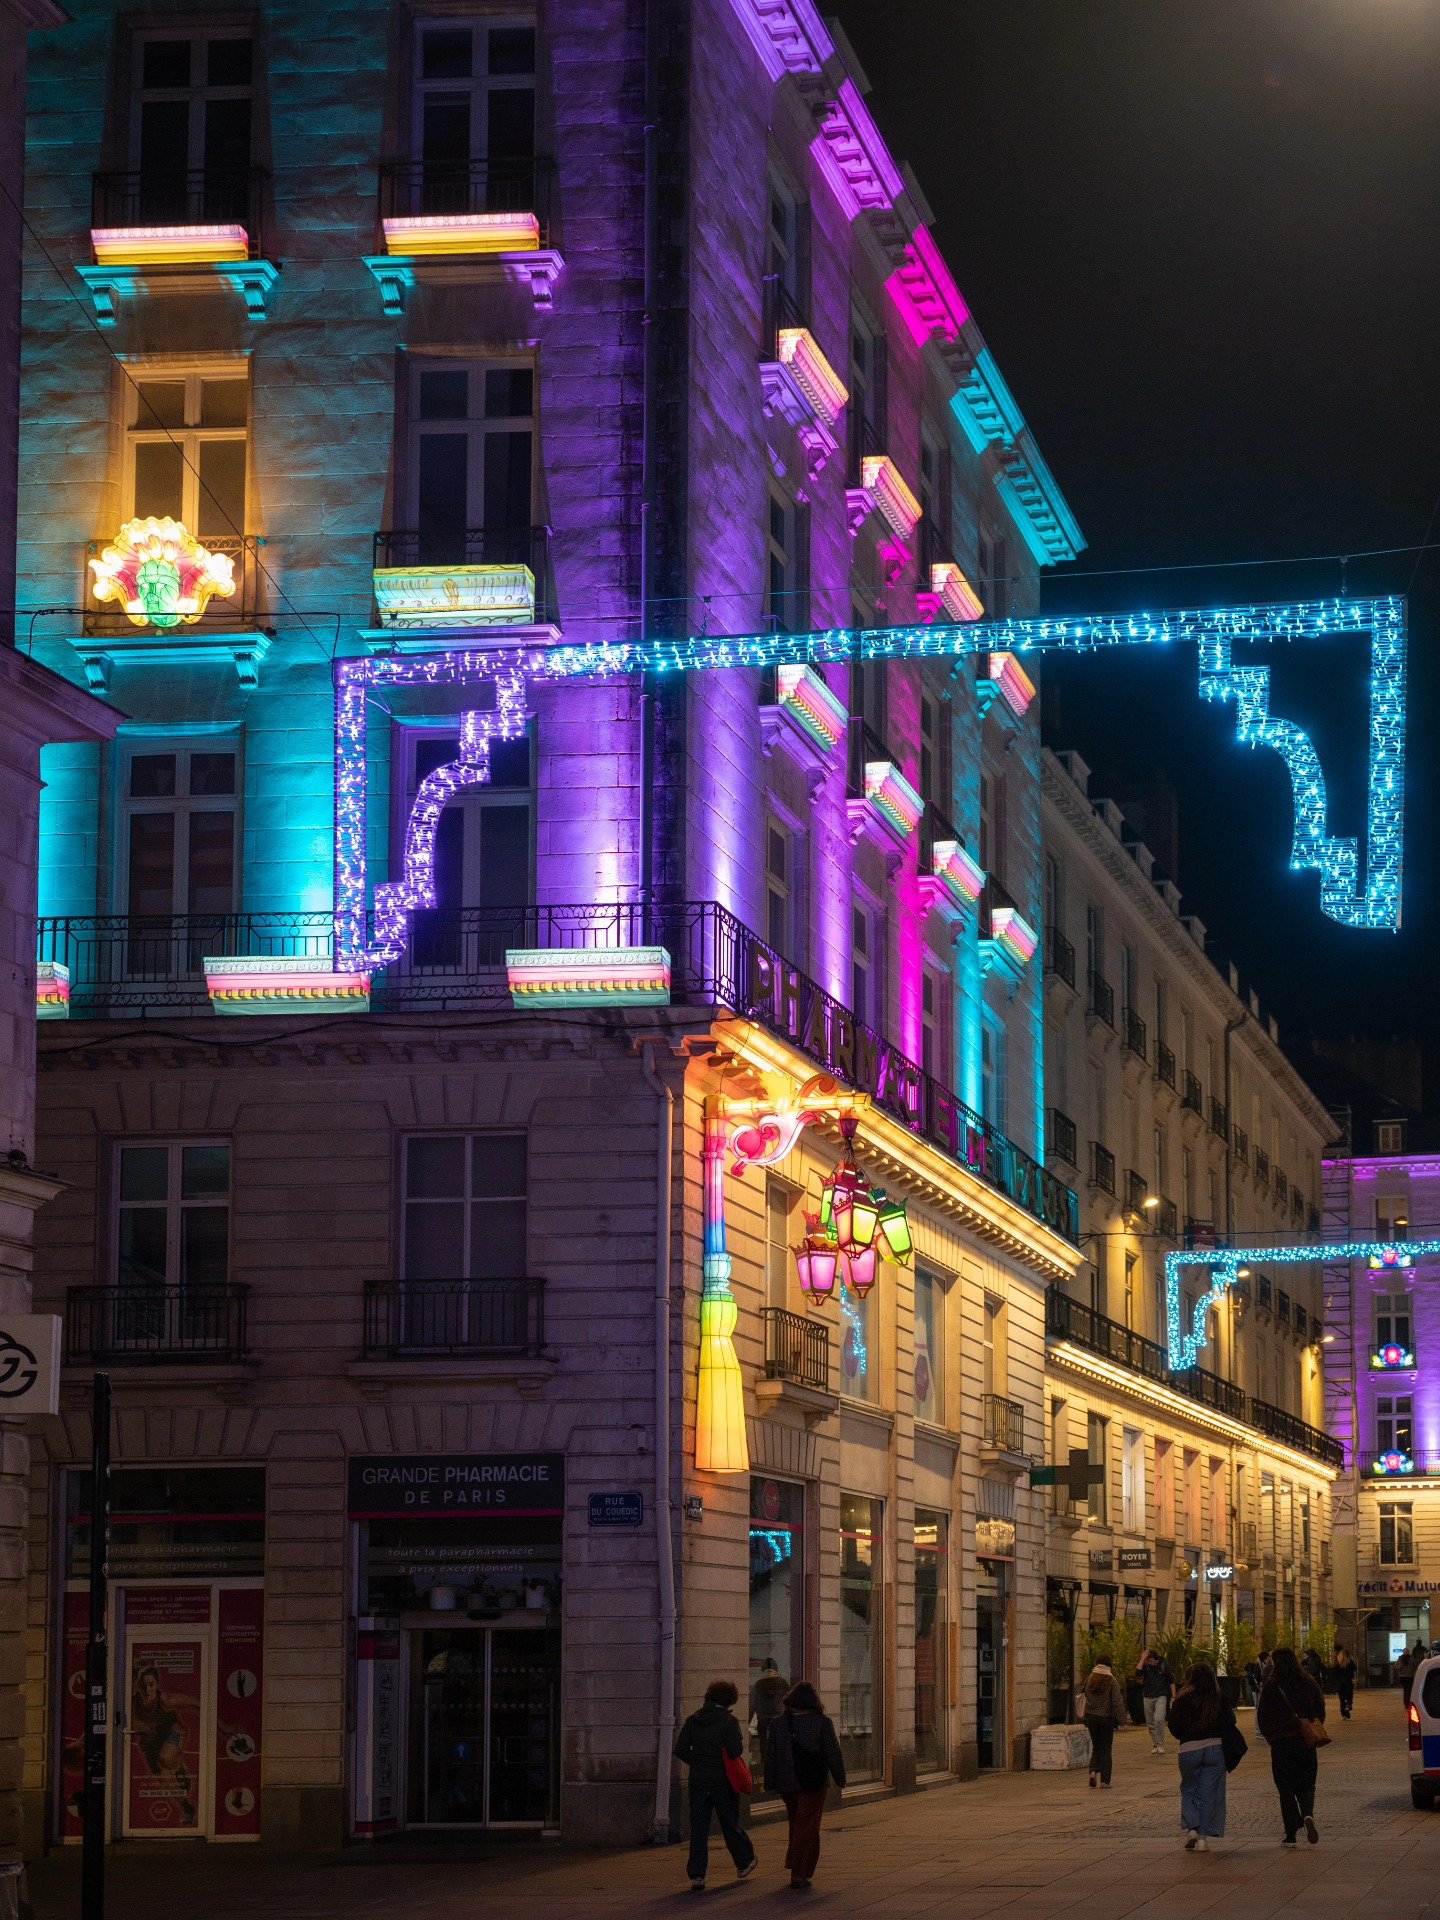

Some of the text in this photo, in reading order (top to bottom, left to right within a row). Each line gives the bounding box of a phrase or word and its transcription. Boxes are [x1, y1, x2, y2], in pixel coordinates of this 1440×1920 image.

[362, 1465, 549, 1484] GRANDE PHARMACIE
[404, 1489, 506, 1504] DE PARIS
[605, 1497, 625, 1505] RUE
[591, 1508, 602, 1516] DU
[388, 1546, 535, 1557] toute la parapharmacie
[1121, 1553, 1148, 1561] ROYER
[409, 1564, 435, 1574] prix
[439, 1564, 523, 1574] exceptionnels
[1358, 1581, 1388, 1592] rédit
